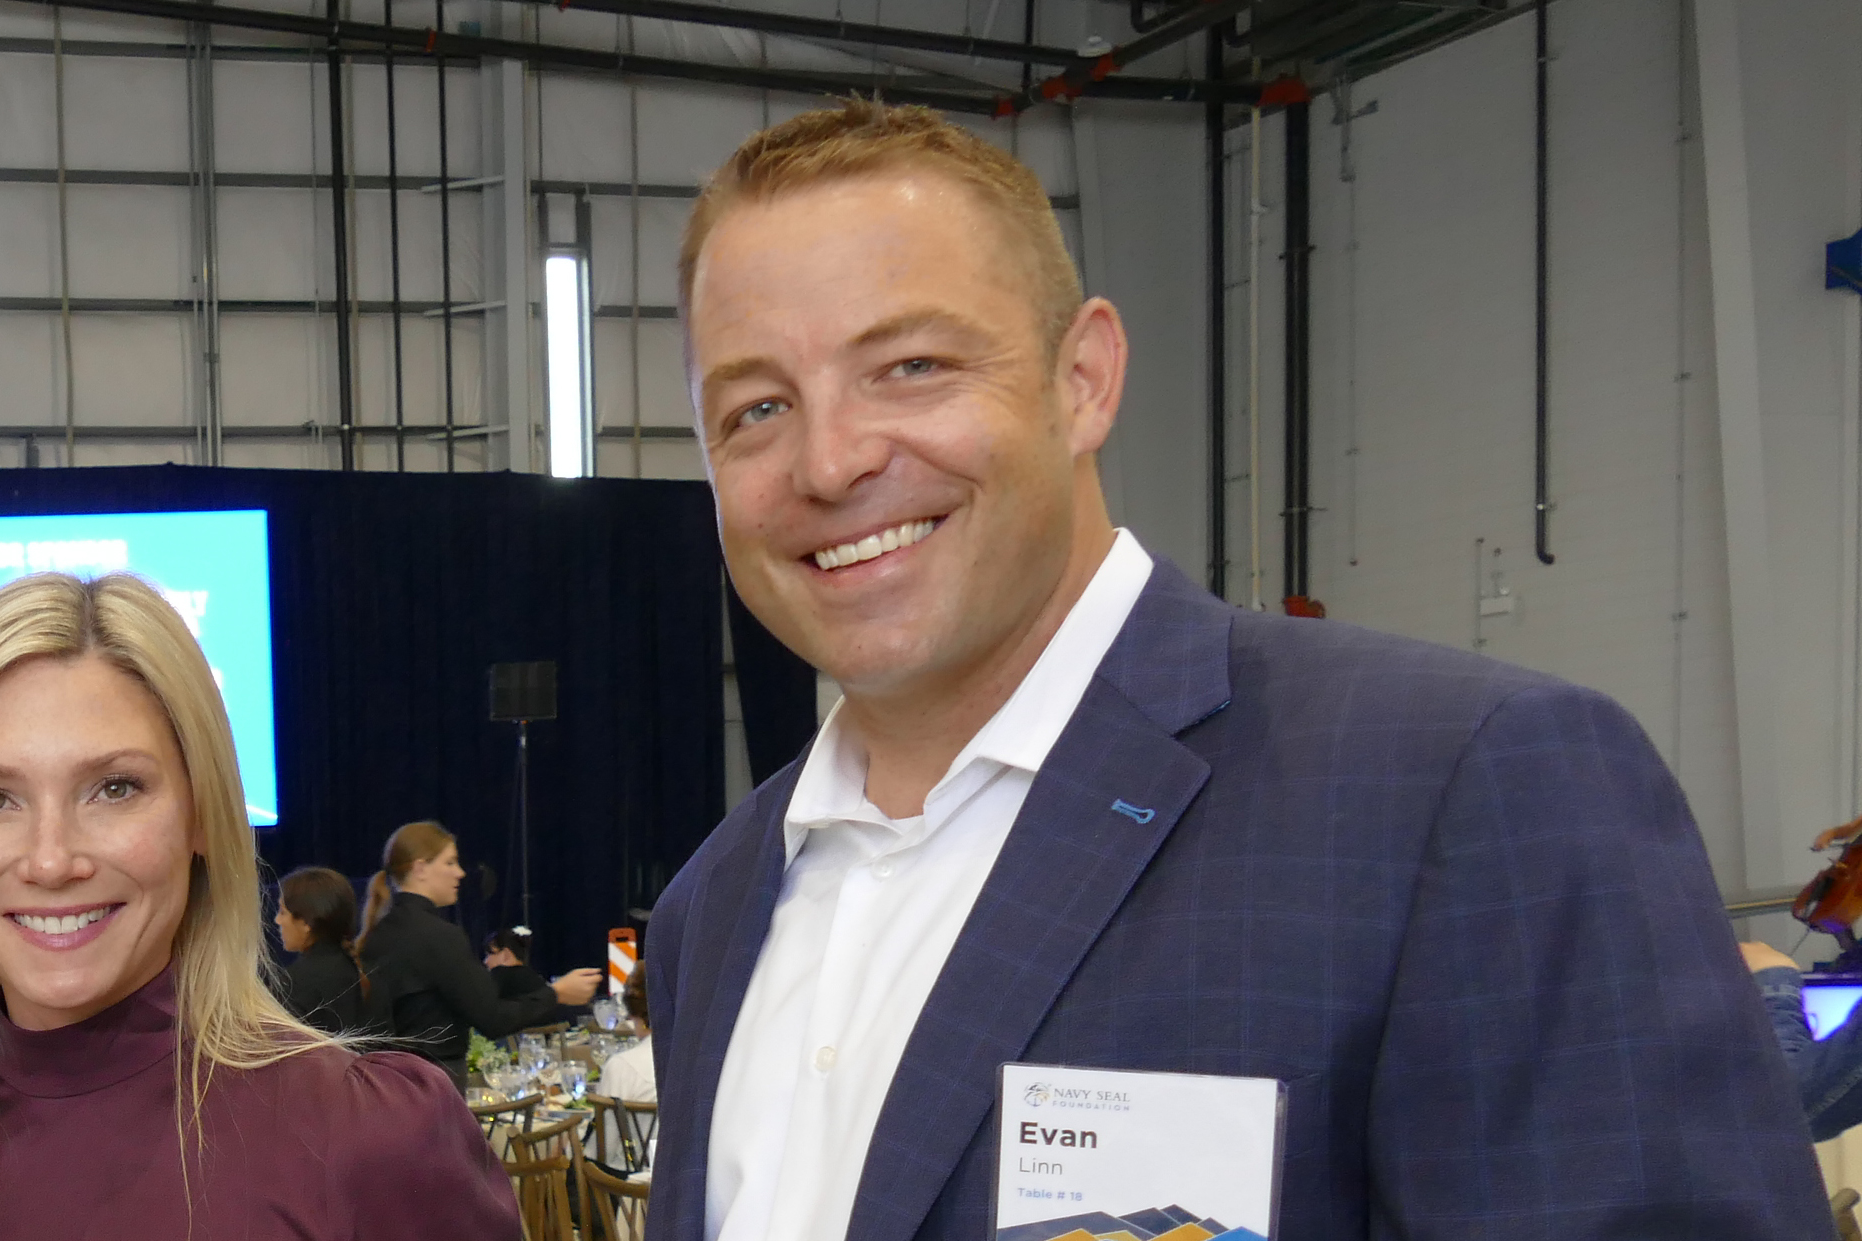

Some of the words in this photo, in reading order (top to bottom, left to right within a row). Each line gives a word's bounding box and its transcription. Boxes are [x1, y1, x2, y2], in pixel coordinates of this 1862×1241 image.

[1053, 1088, 1091, 1100] NAVY
[1096, 1091, 1131, 1103] SEAL
[1052, 1100, 1131, 1112] FOUNDATION
[1019, 1121, 1098, 1149] Evan
[1019, 1157, 1063, 1175] Linn
[1018, 1188, 1053, 1200] Table
[1057, 1190, 1066, 1200] #
[1070, 1191, 1083, 1202] 18
